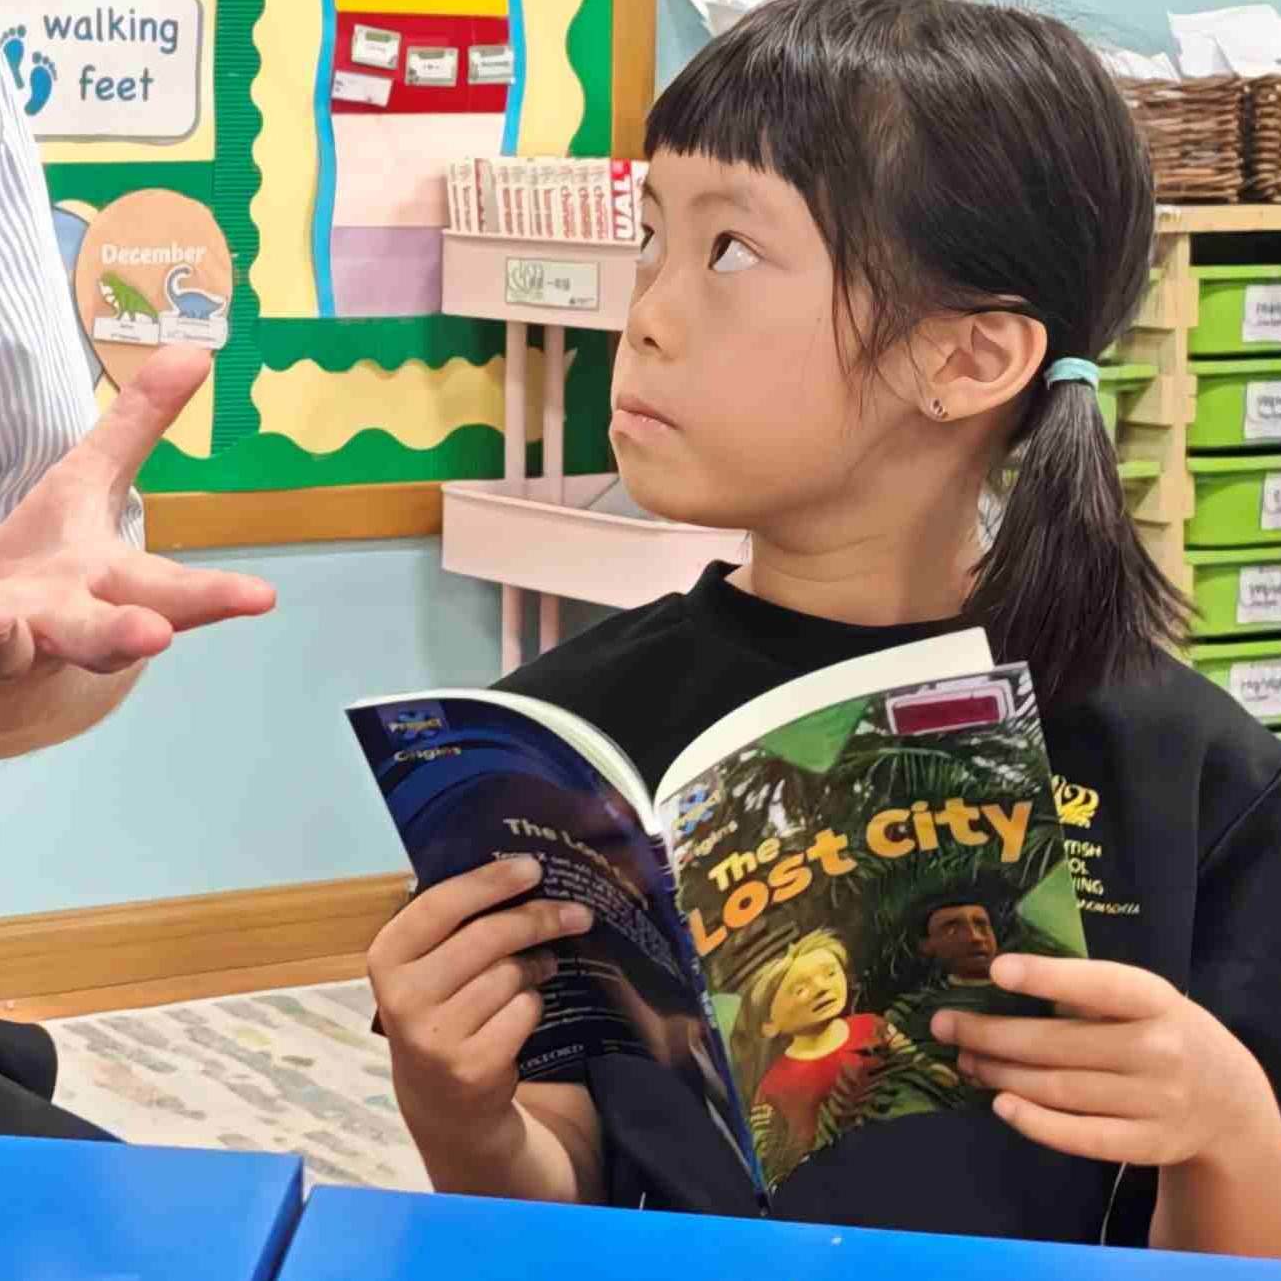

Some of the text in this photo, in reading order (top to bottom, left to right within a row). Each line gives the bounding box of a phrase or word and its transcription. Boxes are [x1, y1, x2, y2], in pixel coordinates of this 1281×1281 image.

[43, 7, 180, 54] walking
[79, 66, 155, 102] feet
[101, 242, 208, 265] December
[503, 817, 558, 842] The
[708, 837, 782, 892] The
